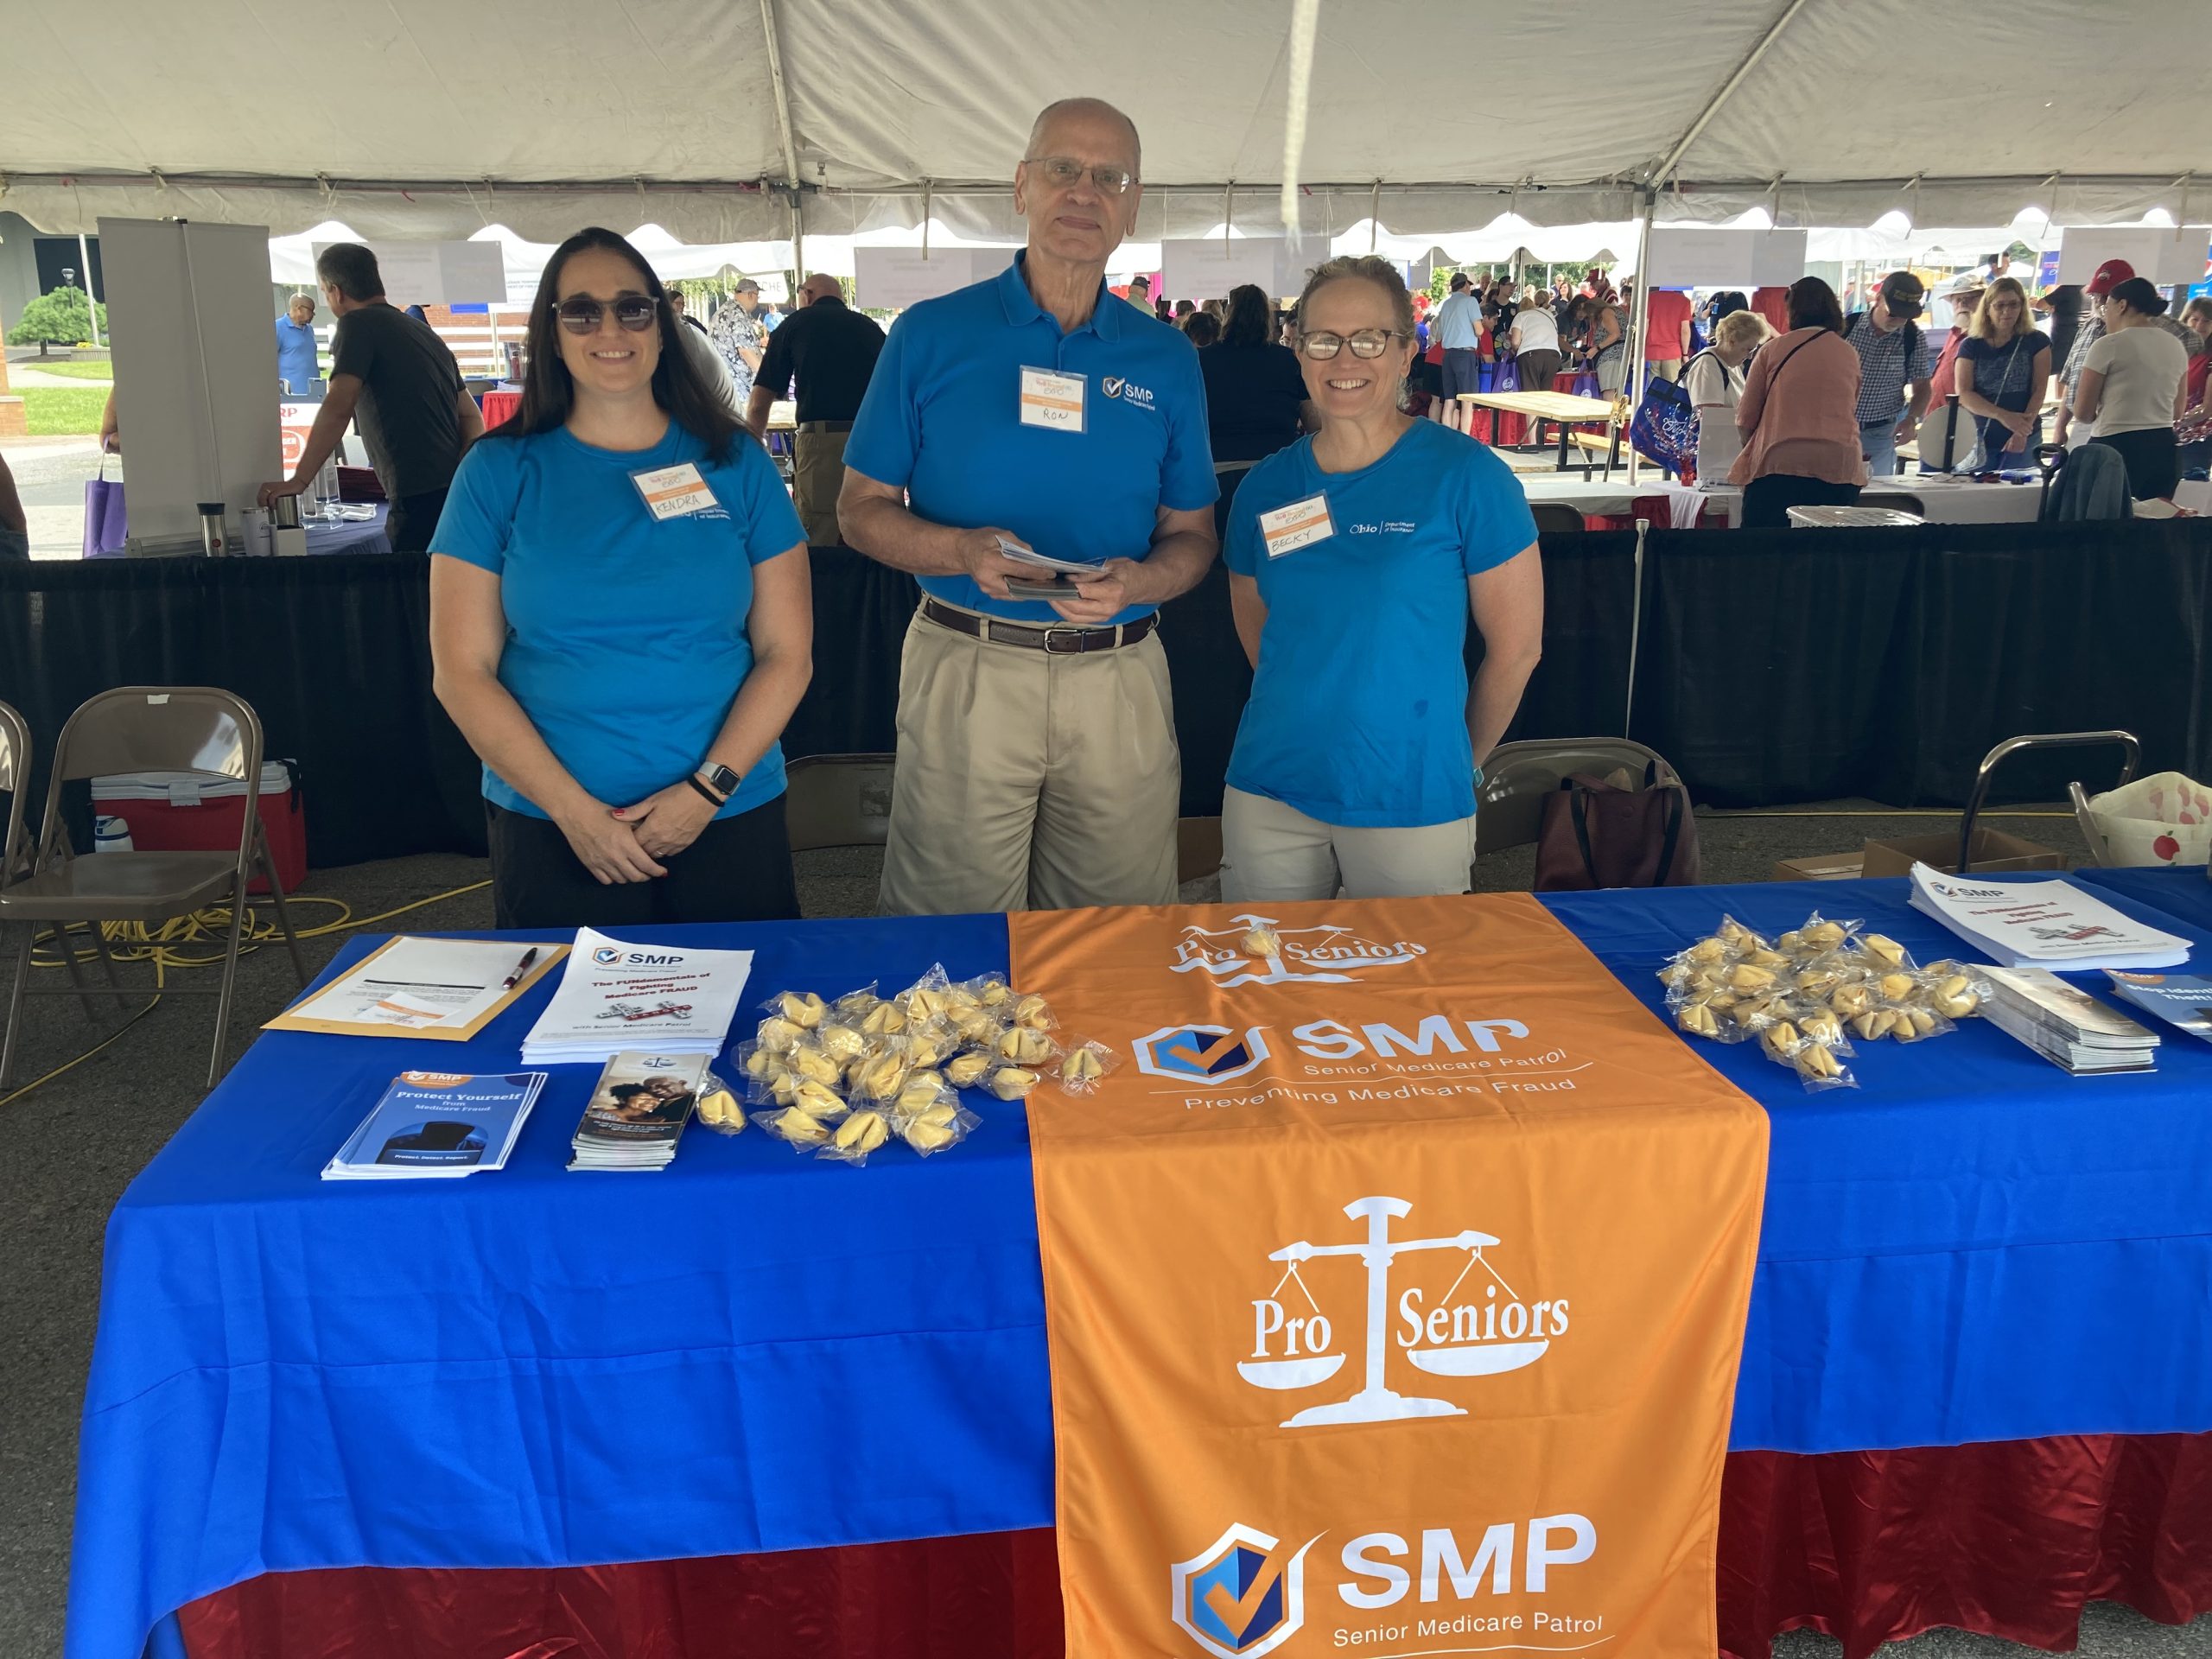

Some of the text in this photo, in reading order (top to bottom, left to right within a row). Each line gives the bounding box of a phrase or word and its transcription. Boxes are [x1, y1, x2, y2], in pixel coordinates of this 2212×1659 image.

[1124, 383, 1154, 403] SMP
[1043, 408, 1069, 421] RON
[655, 494, 702, 515] KENDRA
[1349, 524, 1378, 534] Ohio
[1271, 529, 1312, 553] BECKY
[1957, 887, 2005, 897] SMP
[628, 953, 683, 965] SMP
[1173, 940, 1427, 965] Pro Seniors
[605, 990, 656, 1000] Medicare
[2126, 985, 2166, 995] Stop
[1292, 1014, 1529, 1059] SMP
[1303, 1047, 1567, 1076] Senior Medicare Patrol
[396, 1091, 524, 1102] Protect Yourself
[1185, 1078, 1576, 1109] Preventing Medicare Fraud
[1250, 1284, 1569, 1357] Pro Seniors
[1338, 1513, 1597, 1609] SMP
[1333, 1612, 1603, 1647] Senior Medicare Patrol
